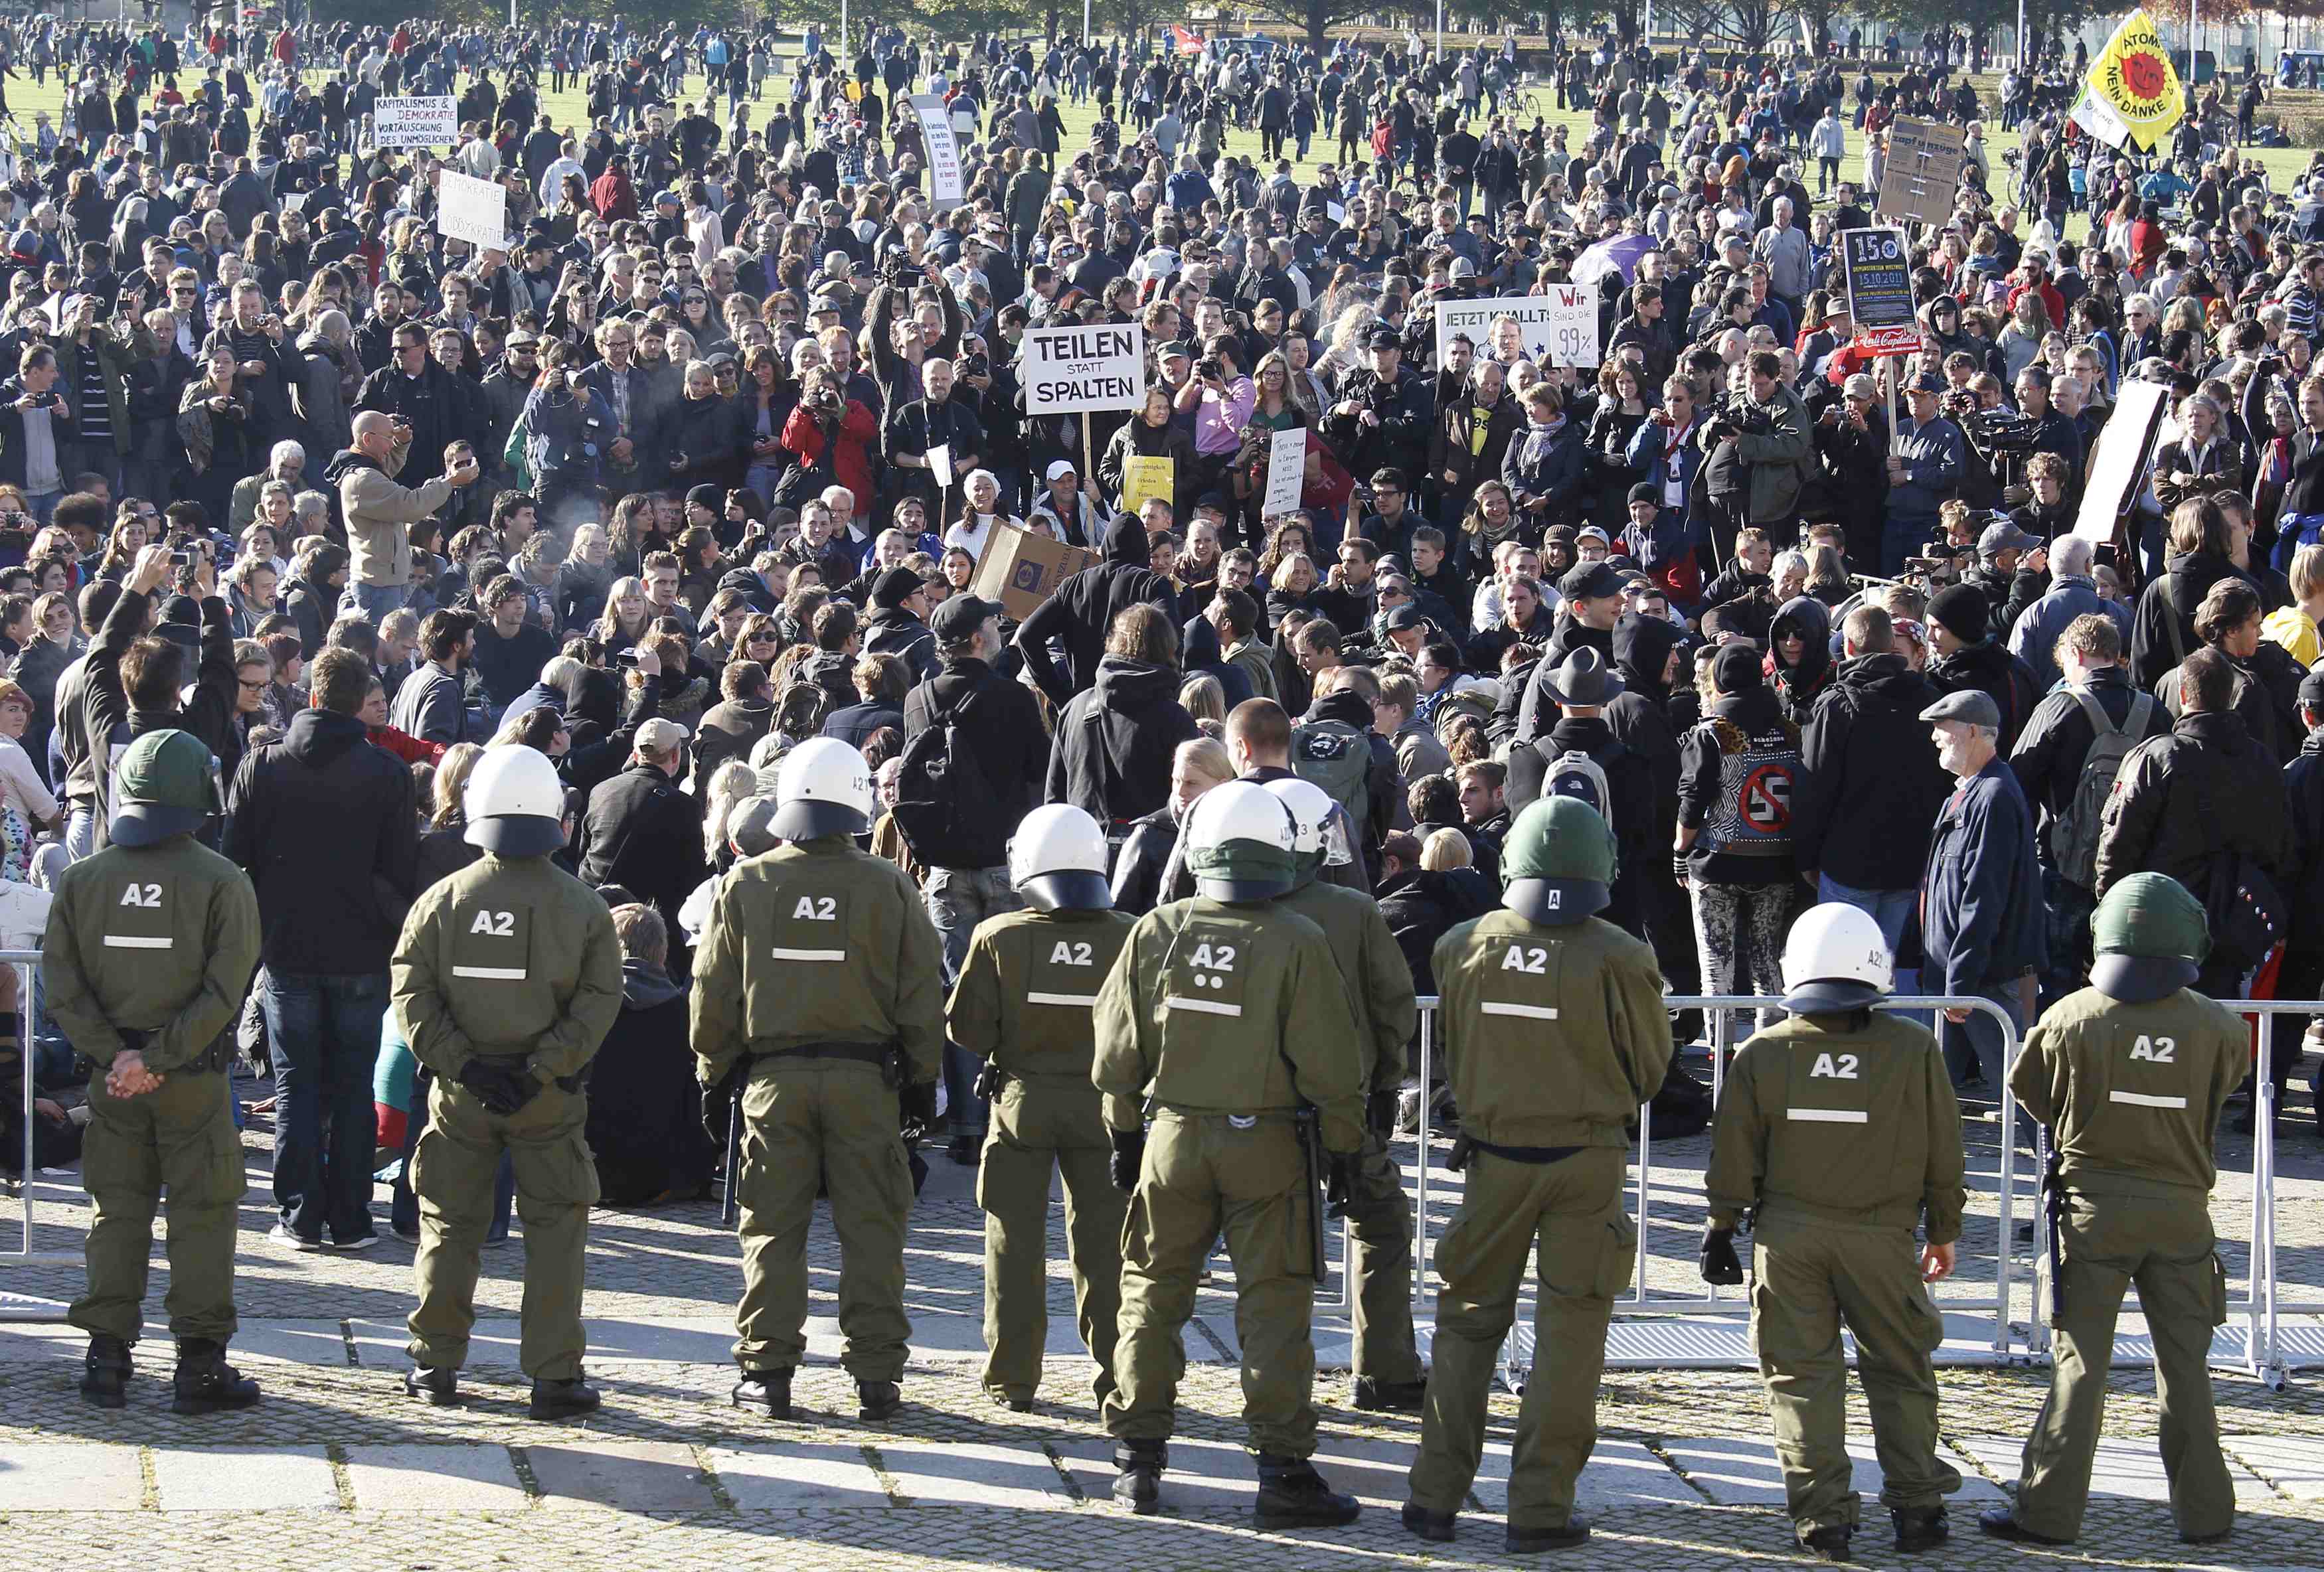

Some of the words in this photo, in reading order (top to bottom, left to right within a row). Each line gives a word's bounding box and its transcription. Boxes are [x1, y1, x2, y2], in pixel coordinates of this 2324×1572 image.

[2107, 66, 2122, 101] NEIN
[376, 99, 436, 110] KAPITALISMUS
[441, 98, 450, 110] &
[398, 110, 456, 120] DEMOKRATIE
[2120, 100, 2166, 118] DANKE
[380, 135, 397, 145] DES
[400, 133, 455, 144] UNMÖGLICHEN
[442, 173, 500, 202] DEMOKRATIE
[1859, 272, 1903, 285] 15.10.2011
[1558, 287, 1588, 307] Wir
[1446, 311, 1485, 327] JETZT
[1553, 312, 1575, 322] SIND
[1578, 309, 1591, 319] DIE
[1033, 331, 1133, 361] TEILEN
[1067, 362, 1104, 374] STATT
[1037, 377, 1134, 403] SPALTEN
[120, 884, 162, 907] A2
[1549, 891, 1559, 907] A
[793, 897, 835, 919] A2
[470, 910, 514, 936] A2
[1050, 941, 1092, 965] A2
[1189, 944, 1235, 971] A2
[1501, 945, 1546, 973] A2
[2129, 1036, 2174, 1062] A2
[1810, 1054, 1858, 1078] A2
